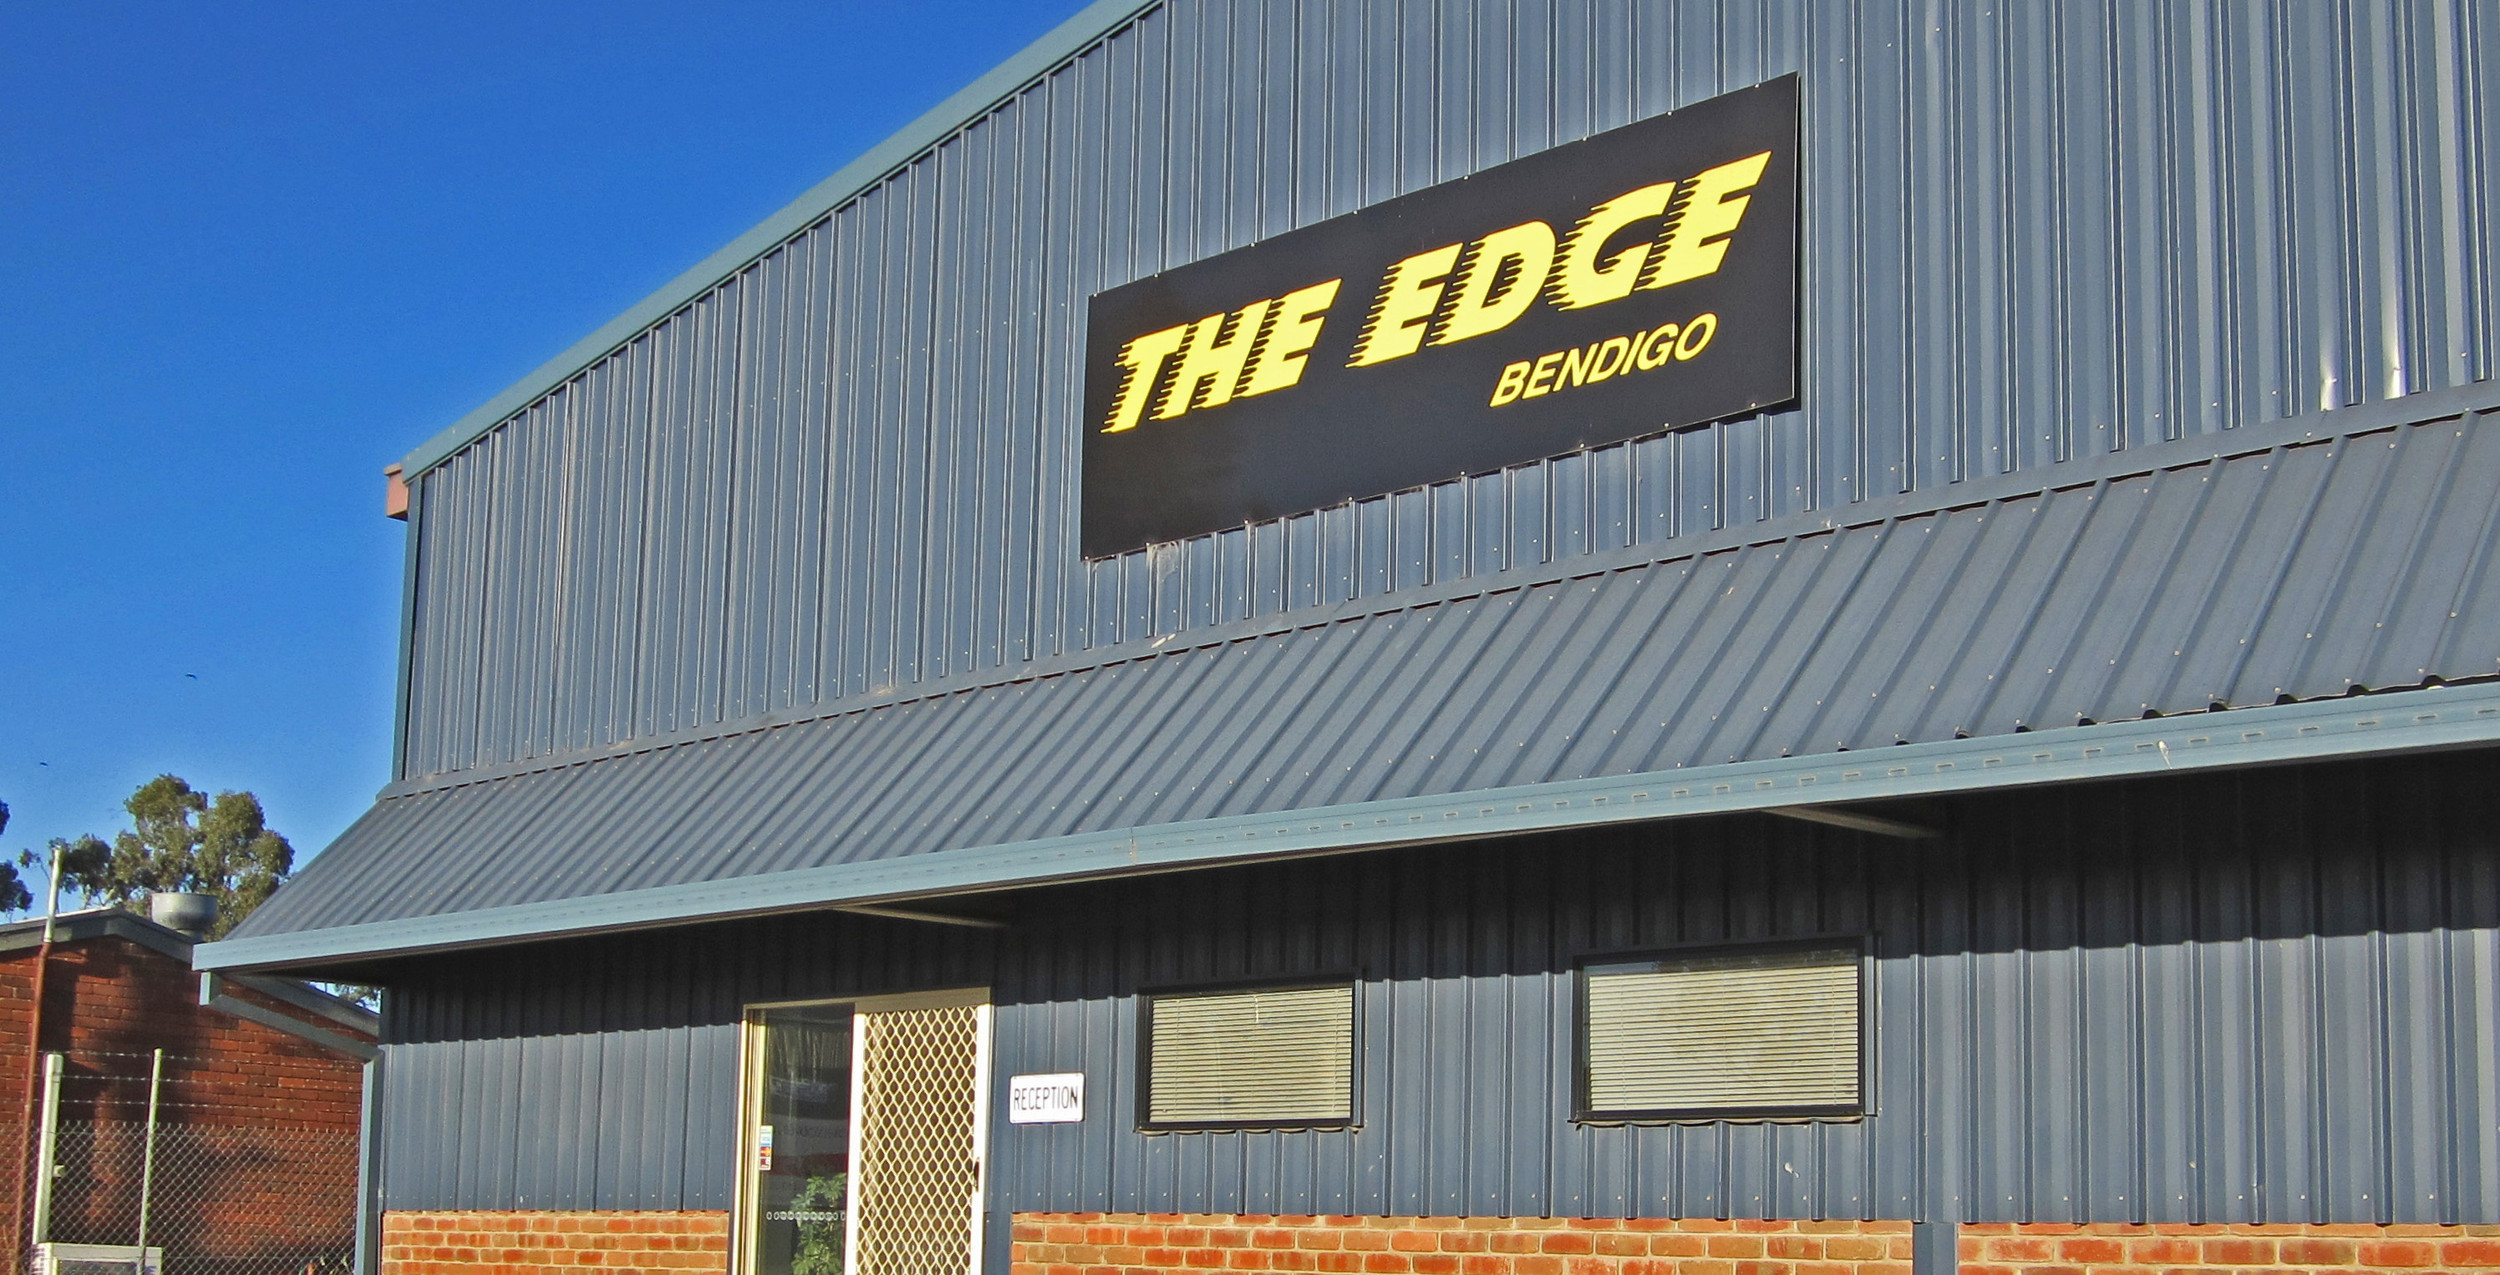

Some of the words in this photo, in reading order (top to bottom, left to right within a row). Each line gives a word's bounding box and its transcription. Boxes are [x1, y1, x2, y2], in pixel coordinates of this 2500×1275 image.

[1099, 278, 1342, 434] THE
[1344, 150, 1772, 368] EDGE
[1489, 312, 1718, 408] BENDIGO
[1013, 1086, 1079, 1111] RECEPTION
